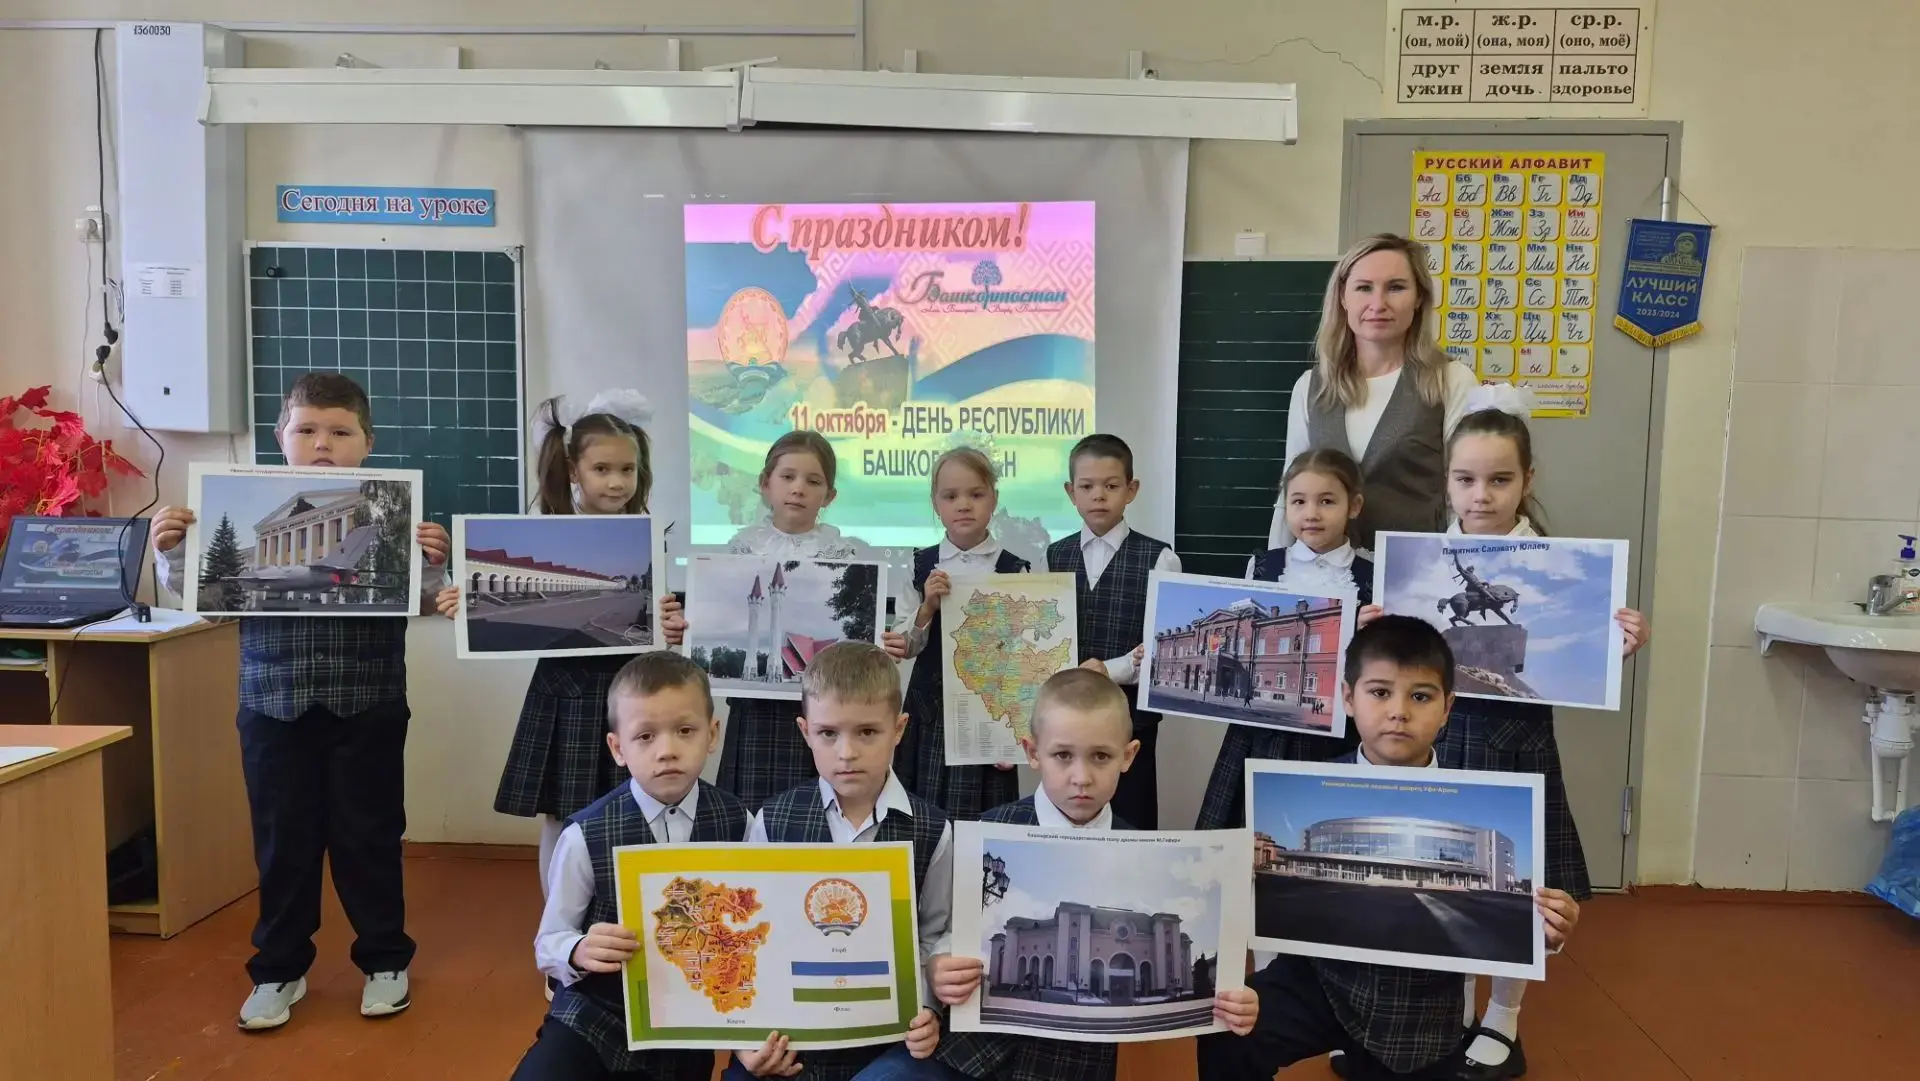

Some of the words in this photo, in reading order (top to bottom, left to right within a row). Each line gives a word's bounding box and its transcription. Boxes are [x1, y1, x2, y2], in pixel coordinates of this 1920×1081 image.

[1416, 14, 1460, 30] м.р.
[1491, 14, 1537, 30] ж.р.
[1570, 14, 1623, 30] ср.р.
[1405, 35, 1432, 48] (он,
[1436, 34, 1470, 48] мой)
[1477, 35, 1512, 48] (она,
[1518, 35, 1551, 48] моя)
[1560, 35, 1595, 48] (оно,
[1599, 34, 1631, 48] моё)
[1412, 63, 1460, 77] друг
[1480, 63, 1544, 75] земля
[1559, 63, 1628, 75] пальто
[1407, 84, 1463, 98] ужин
[1486, 83, 1534, 96] дочь
[1552, 83, 1631, 96] здоровье
[1425, 157, 1503, 169] РУССКИЙ
[1510, 158, 1592, 169] АЛФАВИТ
[1495, 184, 1517, 202] Вв
[282, 190, 379, 214] Сегодня
[384, 196, 413, 213] на
[418, 199, 488, 220] уроке
[752, 205, 783, 249] С
[790, 203, 1028, 262] праздником!
[1626, 276, 1698, 294] ЛУЧШИЙ
[1631, 291, 1688, 307] КЛАСС
[791, 408, 808, 431] 11
[815, 408, 886, 439] октября
[901, 406, 953, 438] ДЕНЬ
[959, 408, 1085, 434] РЕСПУБЛИКИ
